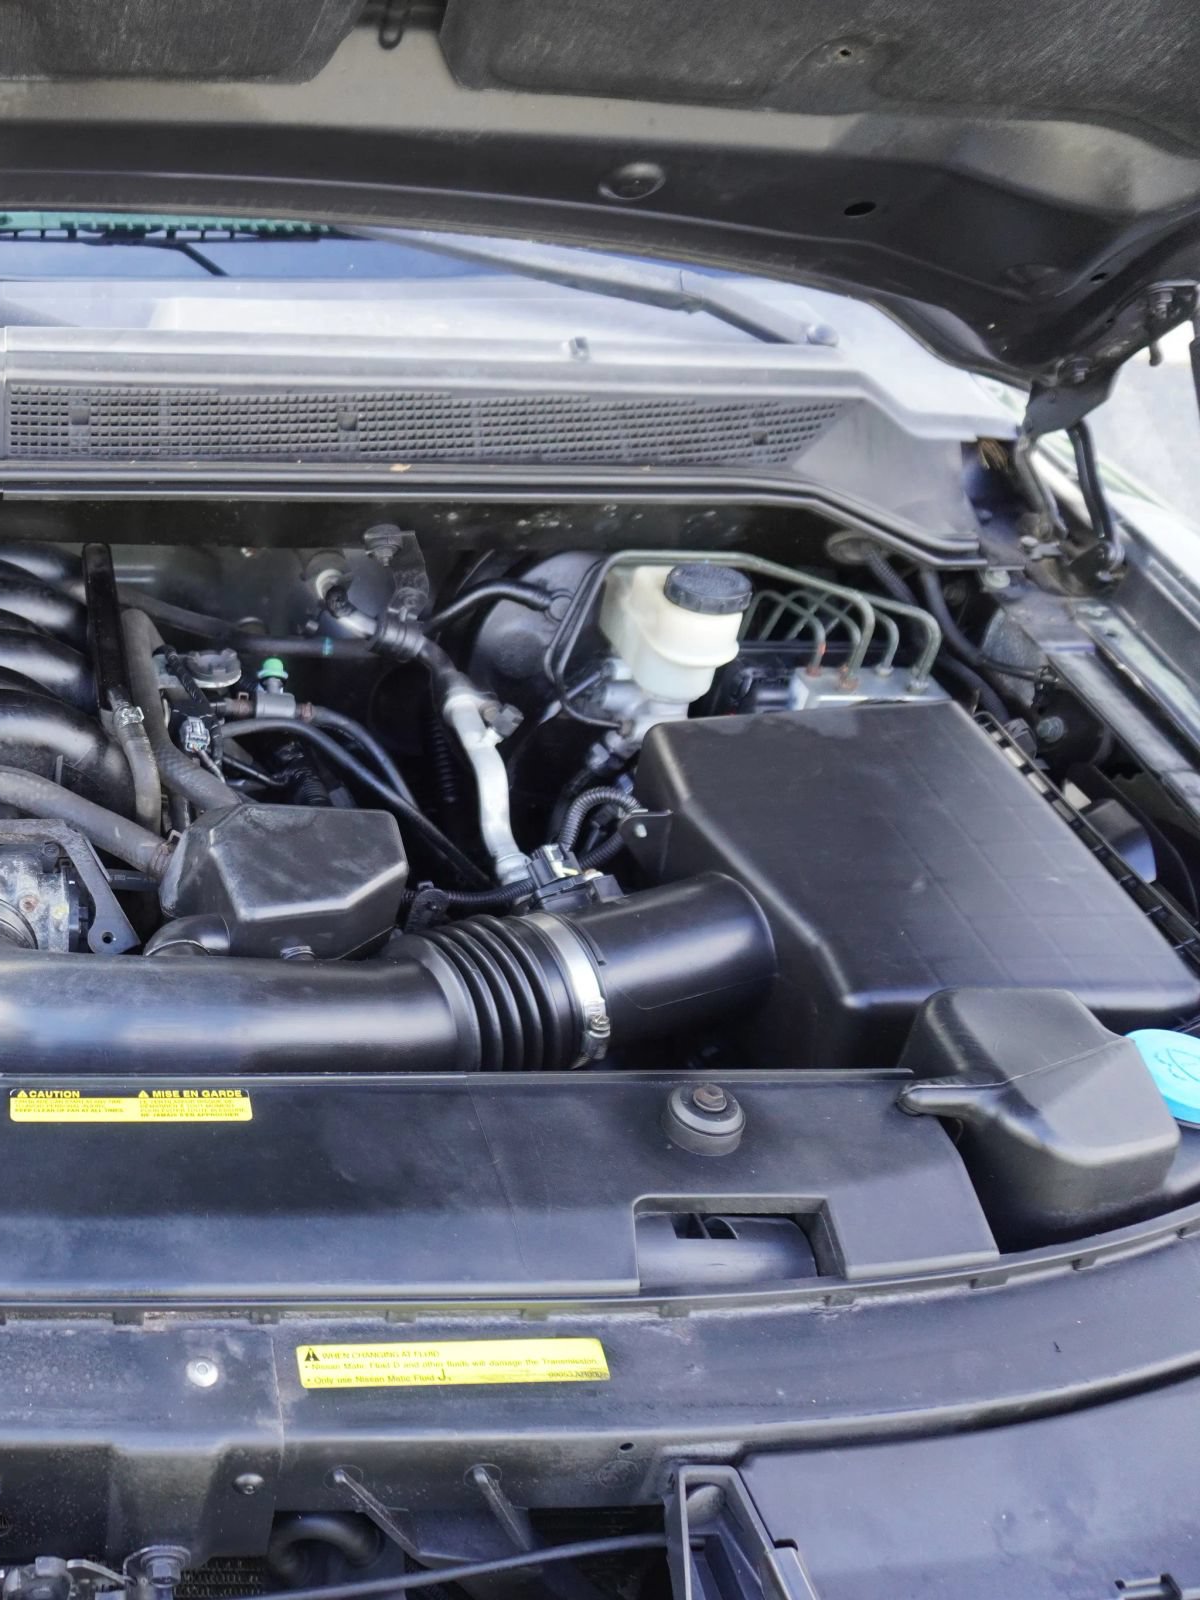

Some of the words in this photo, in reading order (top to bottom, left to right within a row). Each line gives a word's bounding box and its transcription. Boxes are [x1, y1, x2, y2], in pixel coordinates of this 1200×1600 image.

[29, 1089, 80, 1098] CAUTION
[152, 1089, 179, 1098] MISE
[183, 1089, 199, 1098] EN
[202, 1089, 242, 1098] GARDE
[489, 1360, 521, 1368] damage
[314, 1377, 333, 1385] Only
